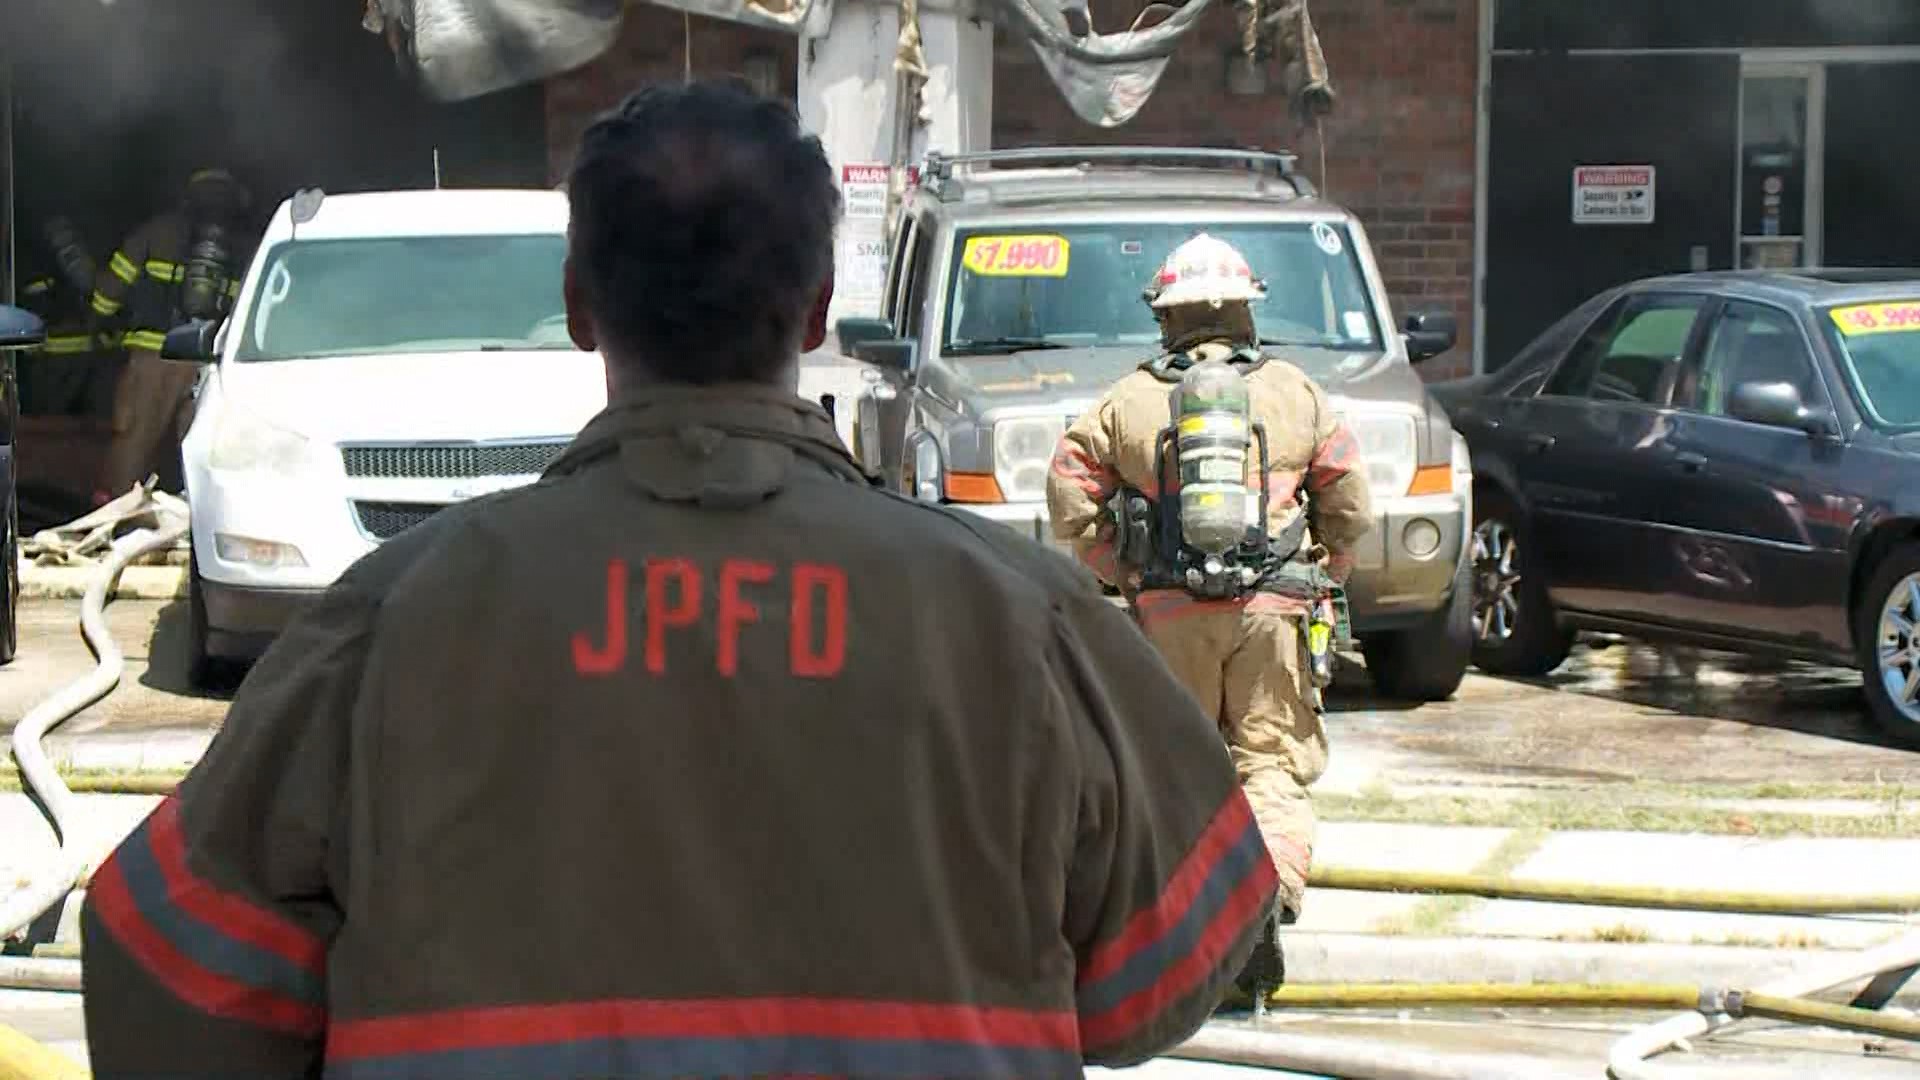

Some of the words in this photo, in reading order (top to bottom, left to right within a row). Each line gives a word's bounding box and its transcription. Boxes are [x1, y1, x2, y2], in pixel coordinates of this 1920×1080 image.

[1583, 173, 1647, 185] WARNING
[1584, 191, 1617, 202] Security
[1584, 204, 1617, 215] Cameras
[571, 557, 849, 678] JPFD
